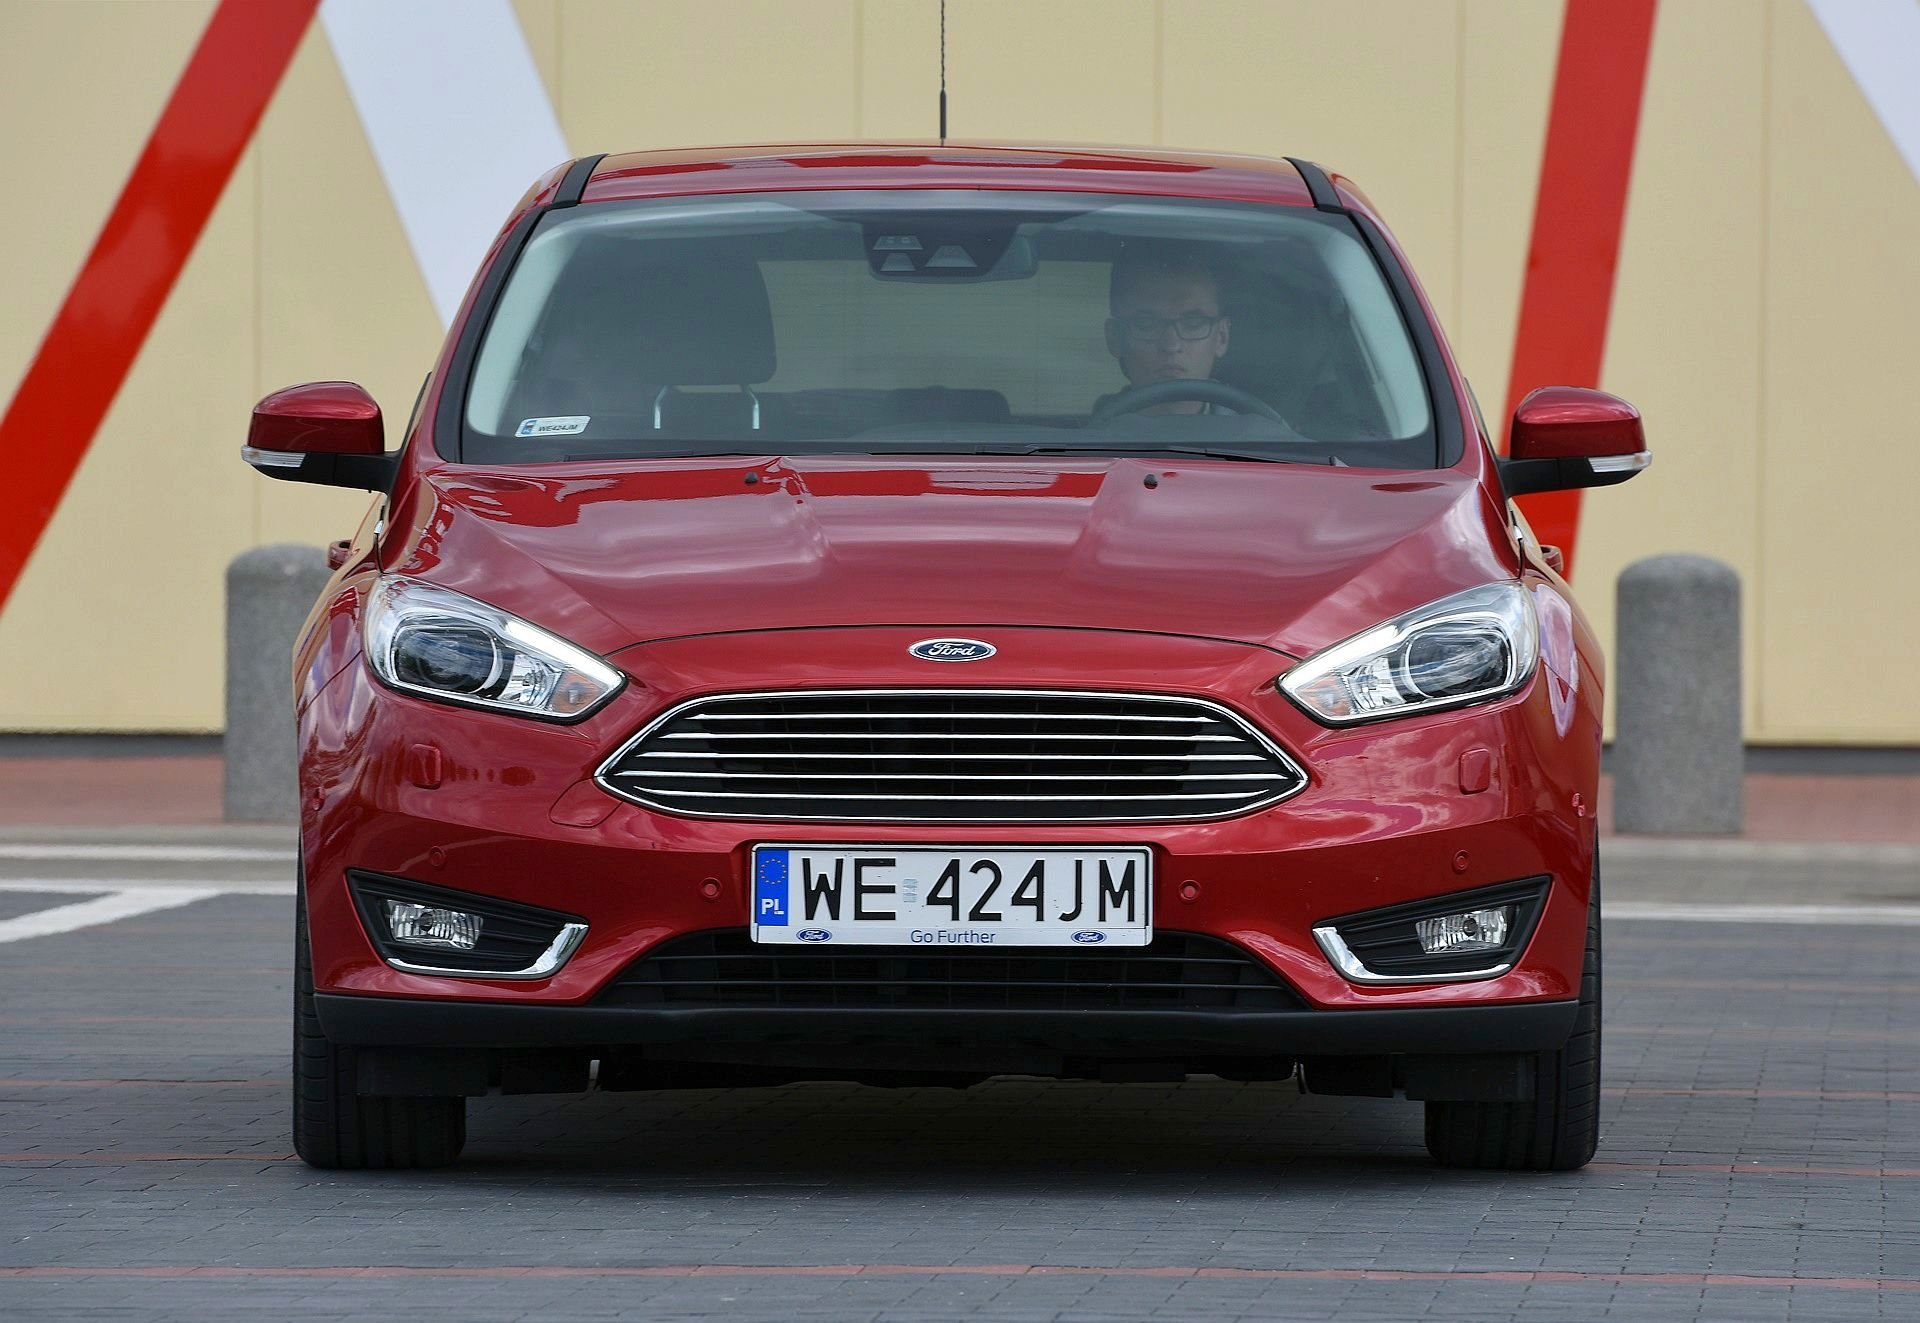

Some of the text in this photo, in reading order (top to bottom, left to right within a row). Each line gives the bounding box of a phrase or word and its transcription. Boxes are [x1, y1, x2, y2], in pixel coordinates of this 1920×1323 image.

[927, 642, 976, 656] Ford
[802, 858, 1136, 922] WE 424JM
[761, 898, 785, 915] PL
[910, 930, 996, 943] Go Further
